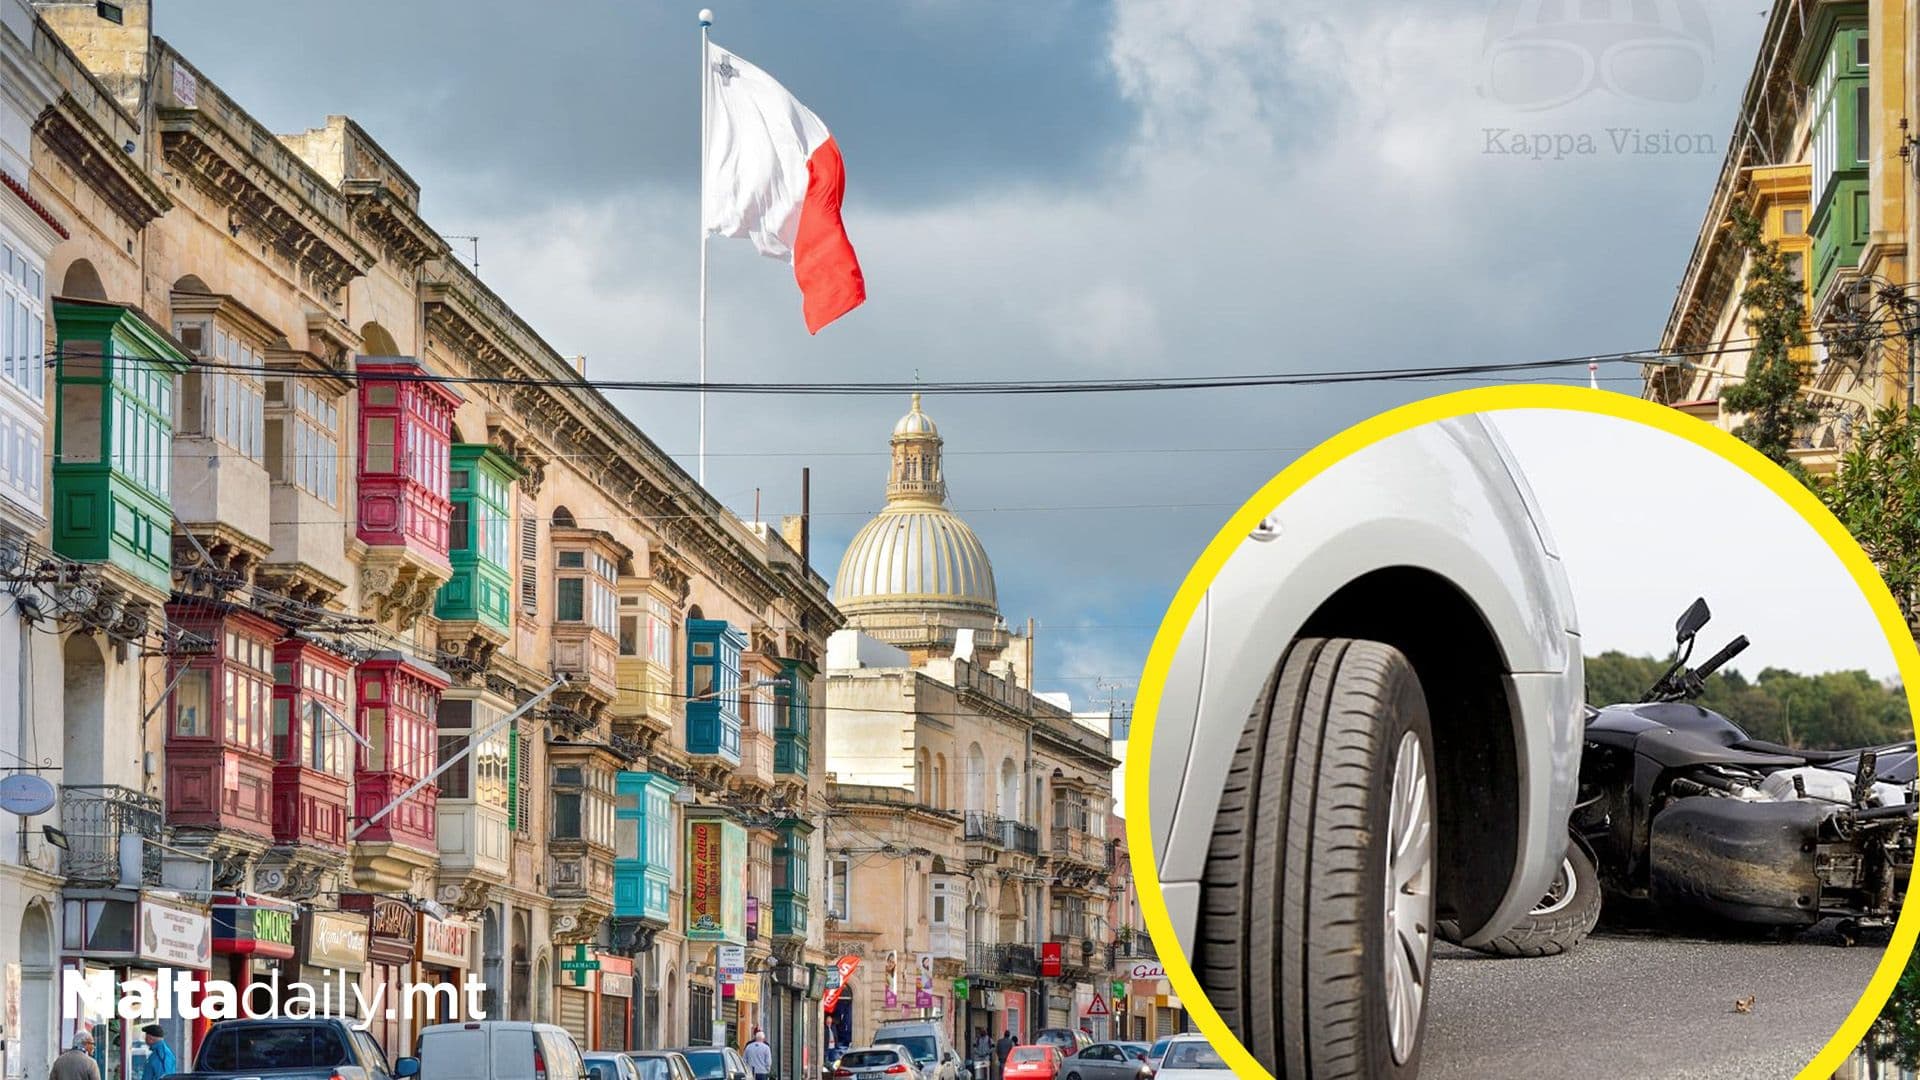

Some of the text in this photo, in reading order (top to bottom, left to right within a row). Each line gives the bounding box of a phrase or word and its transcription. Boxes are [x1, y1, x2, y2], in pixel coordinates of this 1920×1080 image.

[696, 826, 707, 900] SUPER AUDIO
[254, 908, 292, 945] SIMONS
[563, 961, 598, 969] PHARMACY
